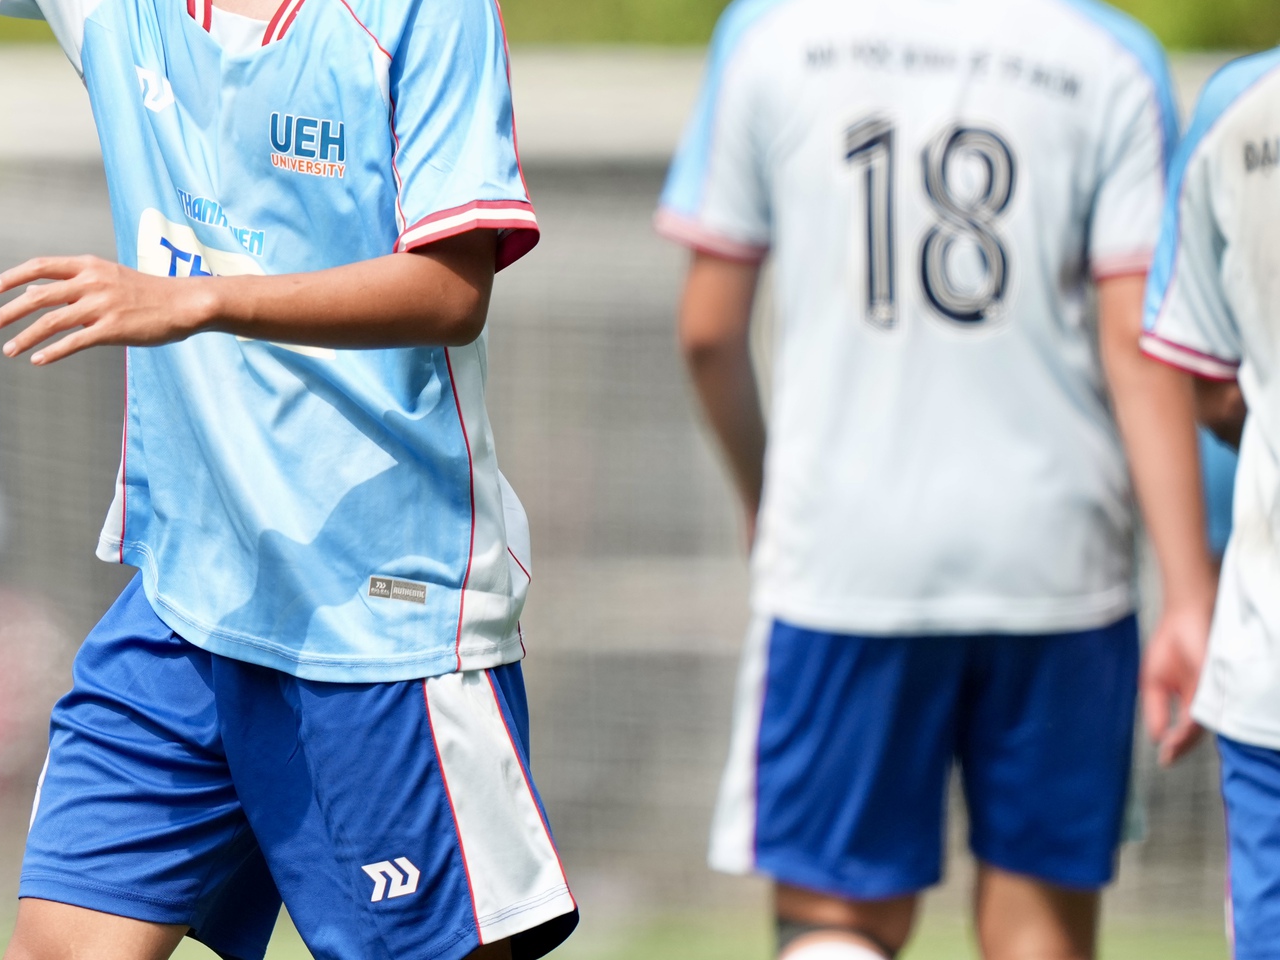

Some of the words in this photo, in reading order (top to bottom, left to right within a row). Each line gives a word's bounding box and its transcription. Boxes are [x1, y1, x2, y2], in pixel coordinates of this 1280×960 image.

[270, 112, 345, 162] UEH
[271, 153, 345, 177] UNIVERSITY
[842, 116, 1018, 330] 18
